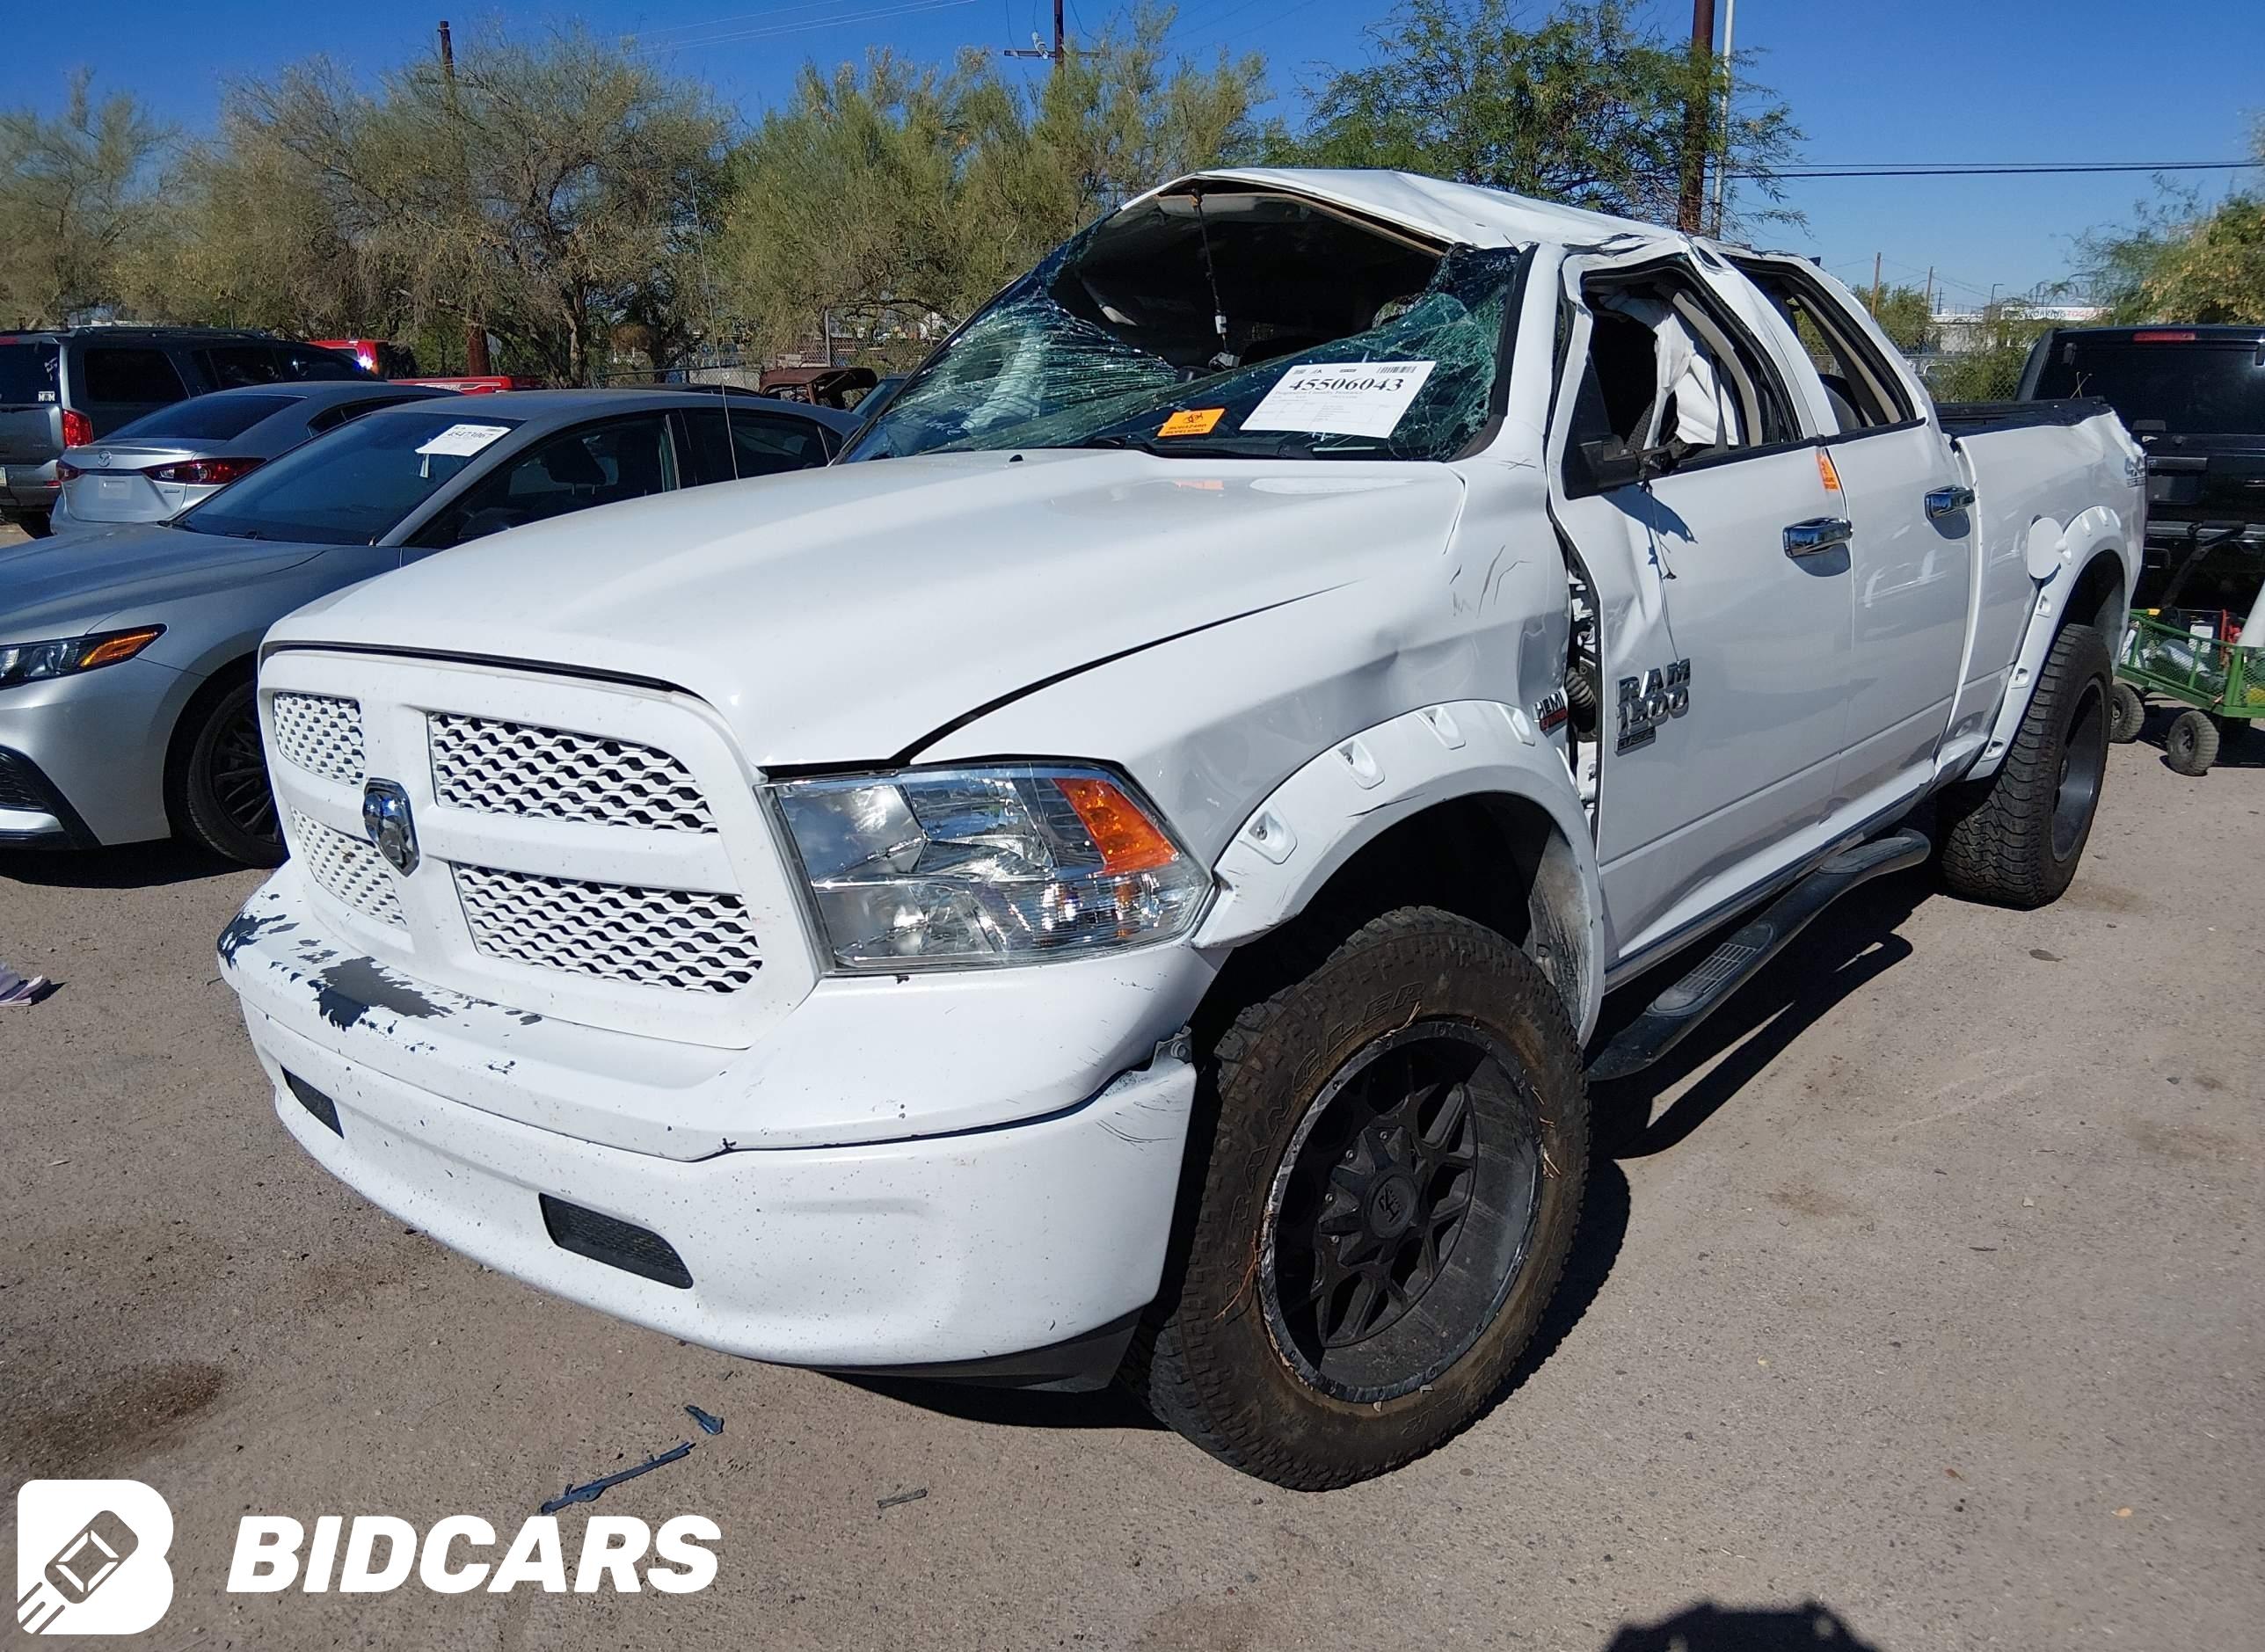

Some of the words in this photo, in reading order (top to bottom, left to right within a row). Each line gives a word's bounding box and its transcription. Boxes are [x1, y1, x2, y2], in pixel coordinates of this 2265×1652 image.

[1289, 378, 1404, 391] 45506043
[1618, 658, 1690, 702] RAM
[1533, 690, 1566, 720] HEMI
